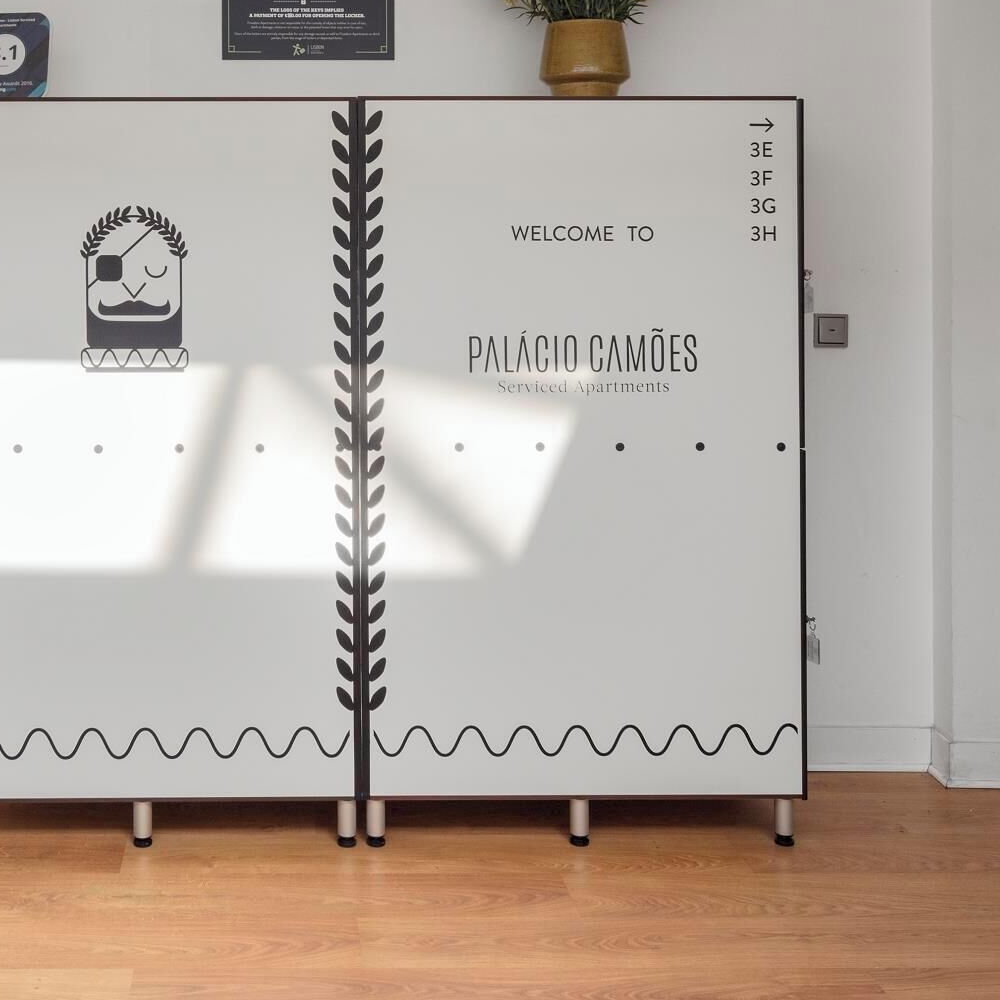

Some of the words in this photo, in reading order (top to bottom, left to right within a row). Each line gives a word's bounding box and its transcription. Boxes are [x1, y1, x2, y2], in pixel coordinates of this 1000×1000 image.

[751, 142, 773, 157] 3E
[751, 171, 773, 186] 3F
[751, 198, 775, 213] 3G
[511, 225, 614, 242] WELCOME
[626, 225, 654, 242] TO
[751, 226, 776, 241] 3H
[469, 329, 578, 374] PALÁCIO
[589, 328, 698, 373] CAMÕES
[497, 380, 567, 394] Serviced
[575, 381, 670, 397] Apartments
